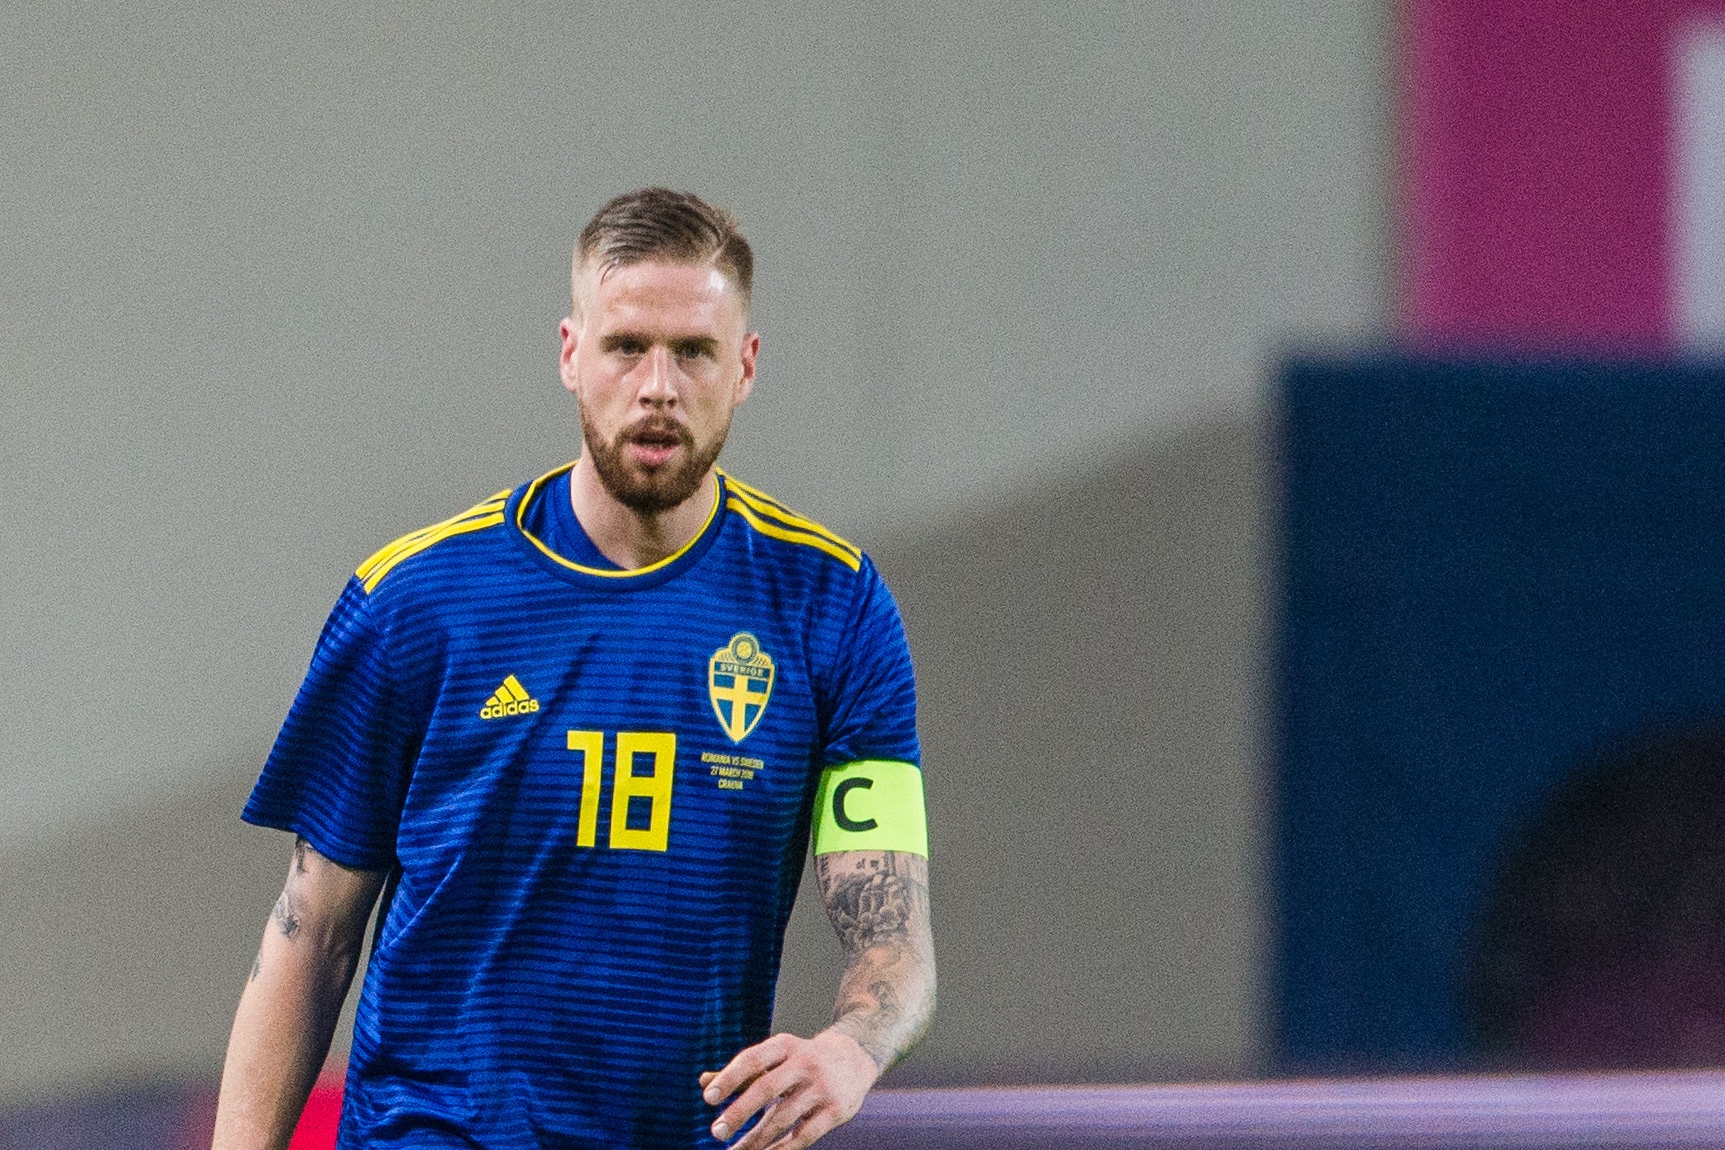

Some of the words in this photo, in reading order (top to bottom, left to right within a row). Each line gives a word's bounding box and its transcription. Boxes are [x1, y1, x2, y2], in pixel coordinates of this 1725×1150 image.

[480, 699, 540, 719] adidas
[710, 765, 719, 776] 27
[566, 729, 677, 853] 18
[832, 776, 879, 833] C
